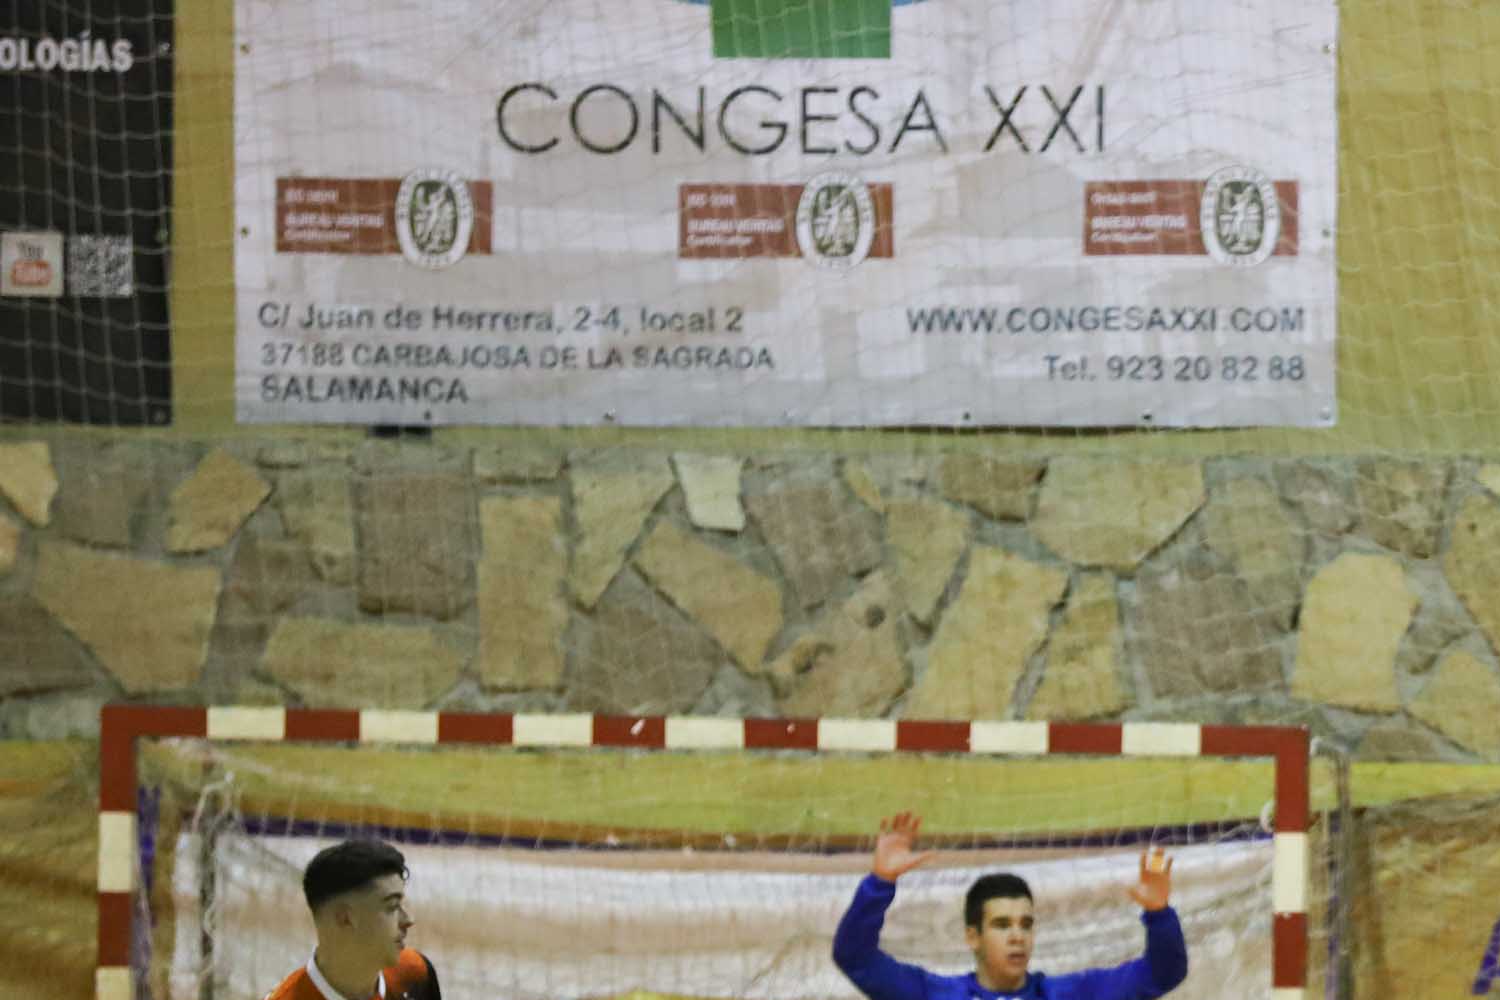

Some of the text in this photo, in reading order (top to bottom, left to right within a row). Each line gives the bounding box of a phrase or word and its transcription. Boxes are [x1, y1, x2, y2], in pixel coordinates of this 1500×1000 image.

[497, 84, 1105, 154] CONGESA XXI
[258, 302, 743, 335] C/ Juan de Herrera, 2-4, local 2
[906, 306, 1304, 333] WWW.CONGESAXXI.COM
[260, 343, 775, 370] 37188 CARBAJOSA DE LA SAGRADA
[1044, 355, 1306, 382] Tel. 923 20 82 88
[260, 374, 470, 404] SALAMANCA
